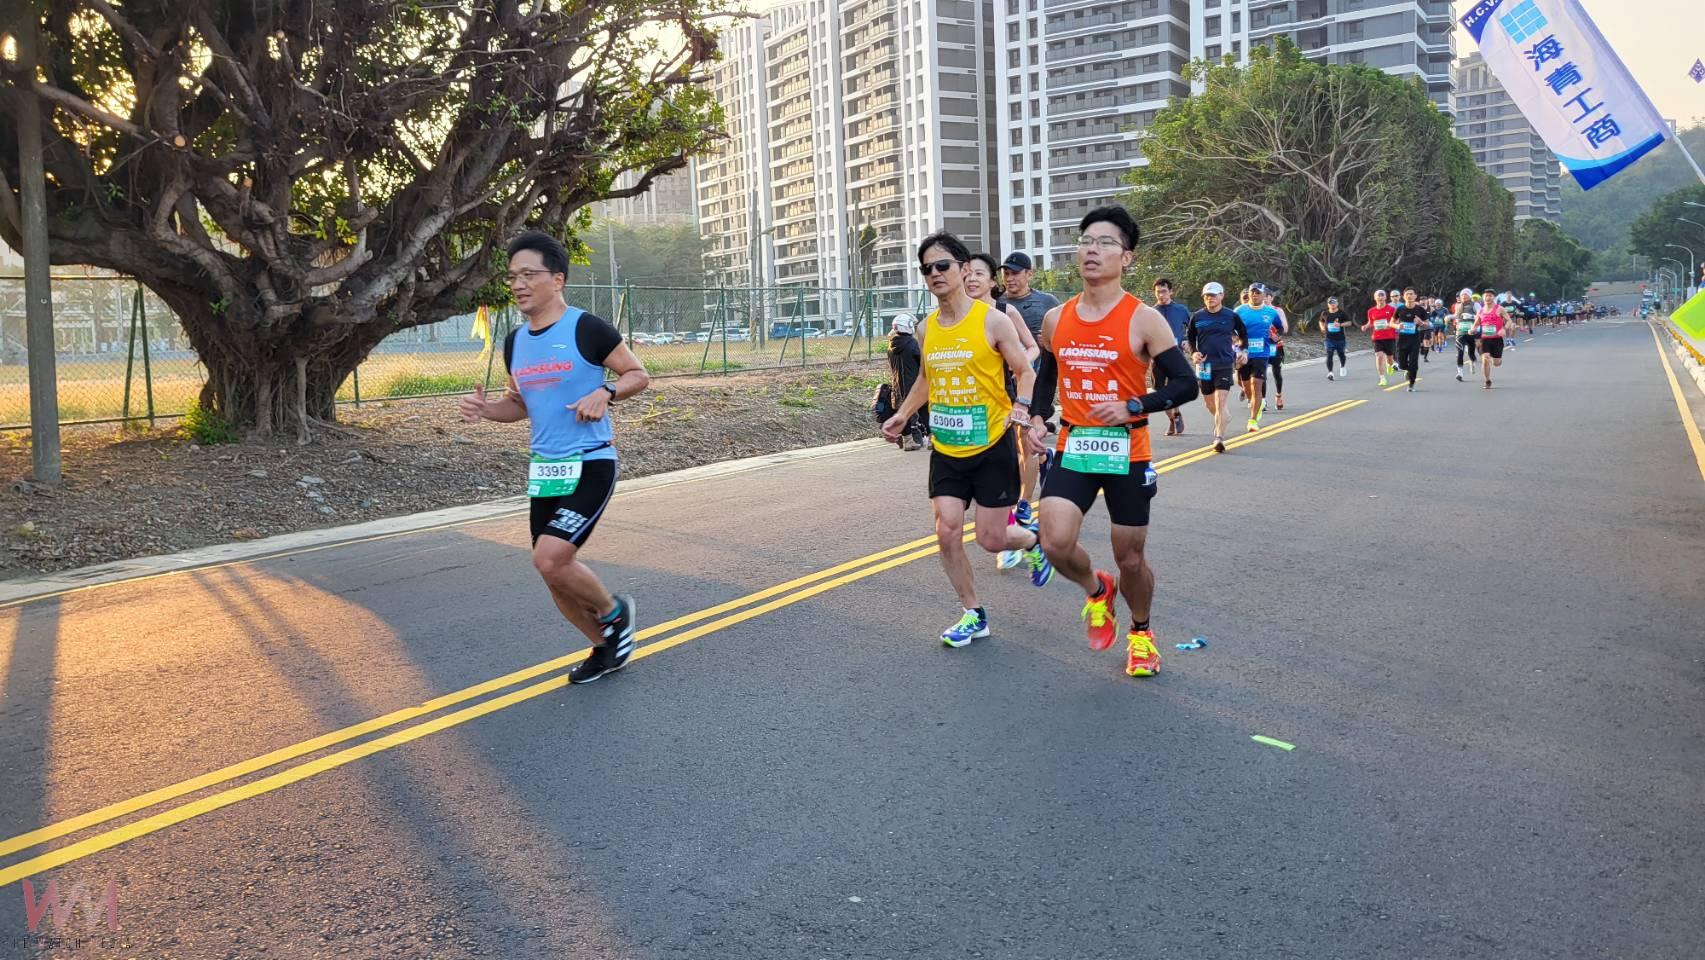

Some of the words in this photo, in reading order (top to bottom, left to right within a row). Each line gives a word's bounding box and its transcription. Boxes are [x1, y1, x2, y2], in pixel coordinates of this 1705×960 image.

[1523, 34, 1622, 150] 海青工商
[1059, 347, 1118, 360] KAOHSIUNG
[933, 414, 964, 428] 63008
[1074, 440, 1120, 453] 35006
[537, 465, 573, 477] 33981
